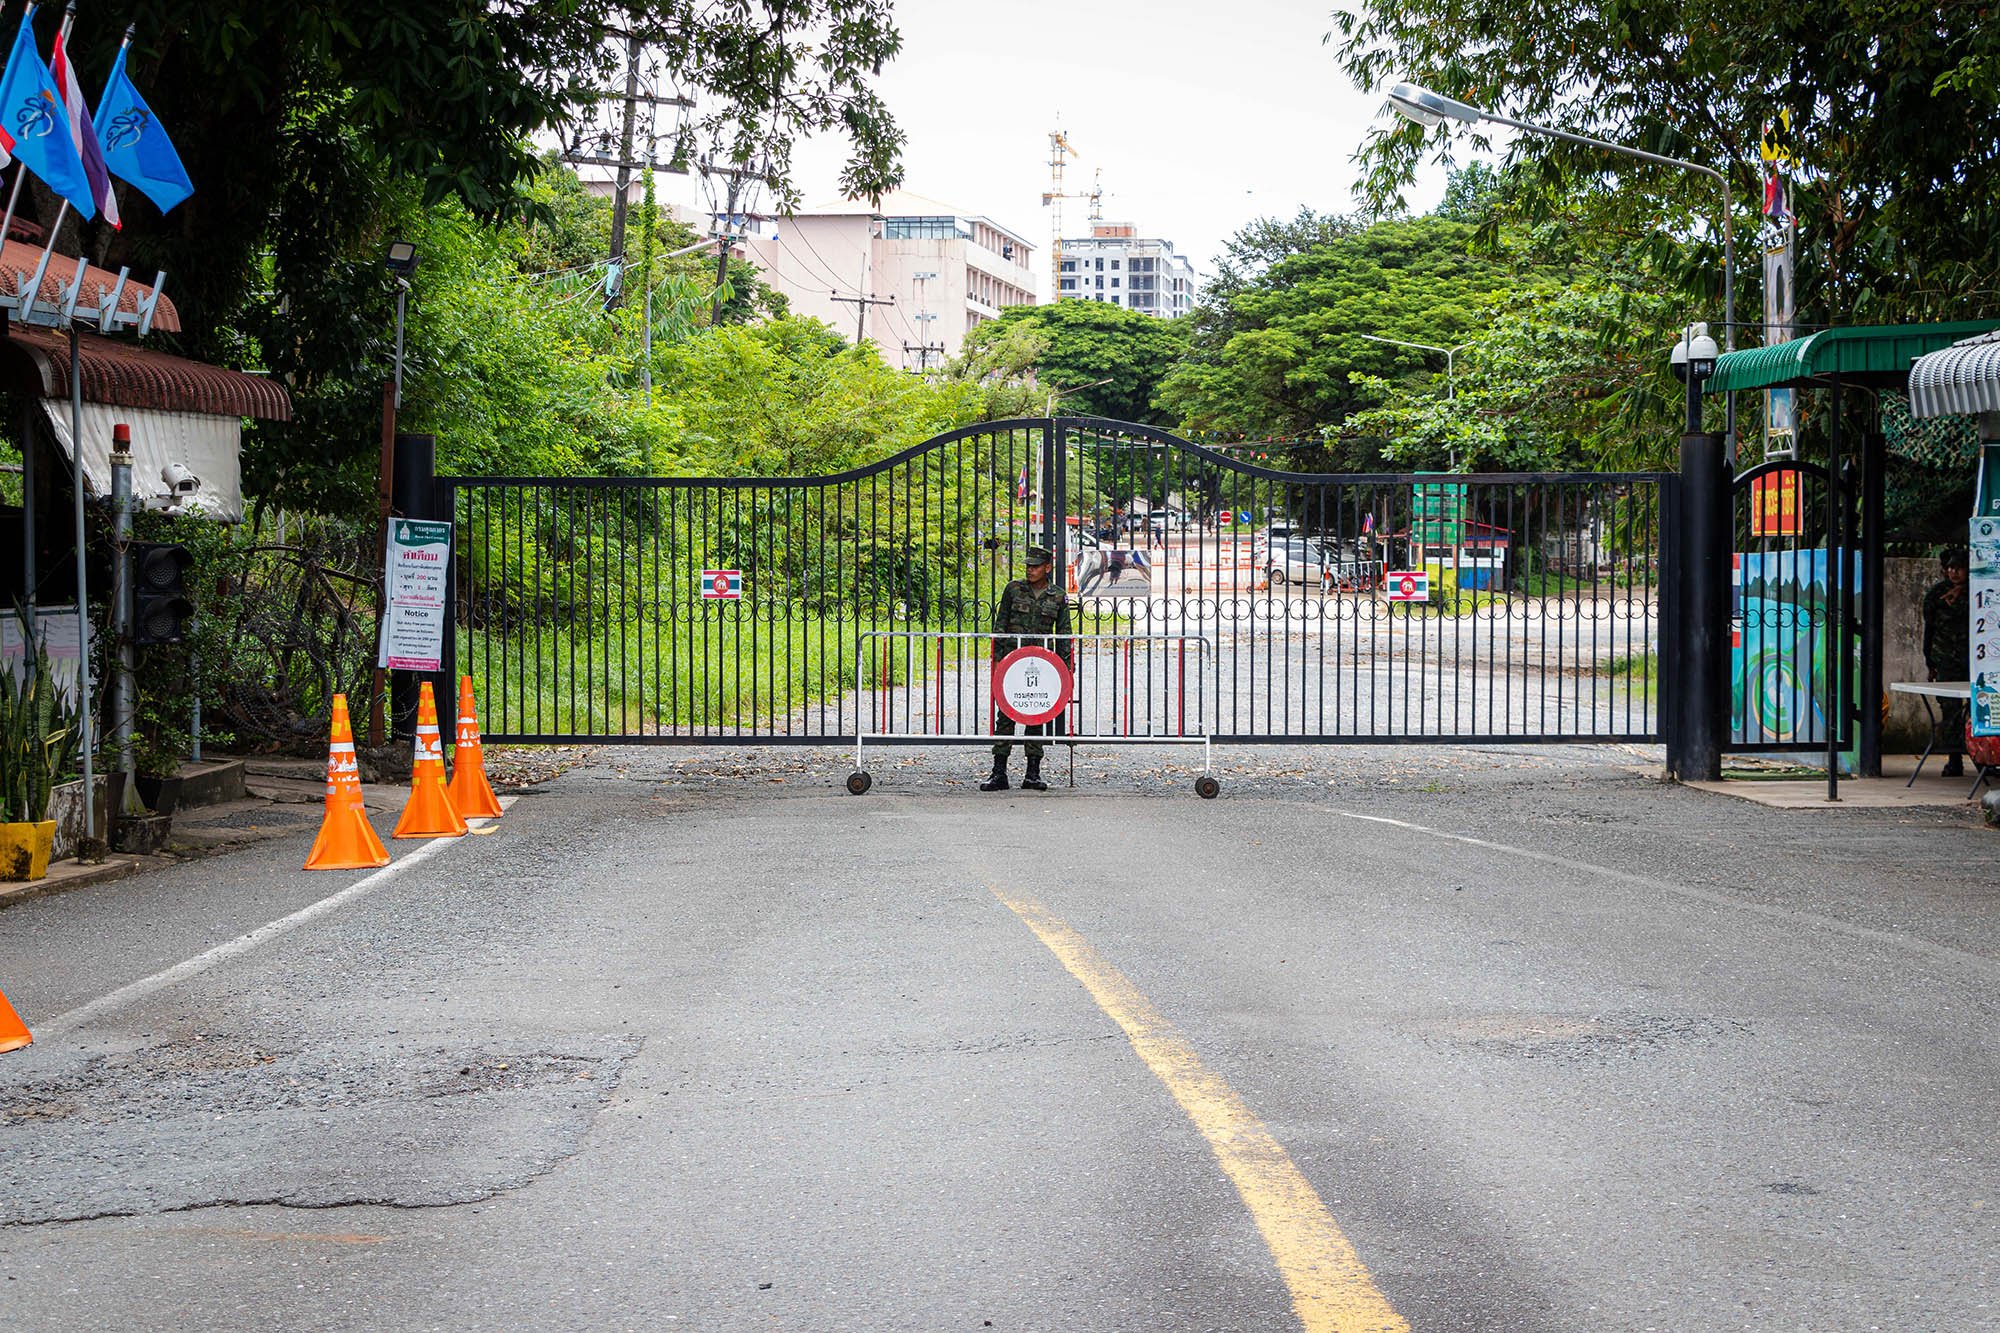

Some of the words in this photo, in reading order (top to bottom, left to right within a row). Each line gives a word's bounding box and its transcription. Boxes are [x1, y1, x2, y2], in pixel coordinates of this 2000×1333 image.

[1975, 590, 1983, 608] 1
[404, 609, 429, 618] Notice
[1976, 617, 1985, 634] 2
[1976, 643, 1986, 660] 3
[1013, 692, 1049, 701] กรมศุลกากร
[1012, 700, 1051, 708] CUSTOMS
